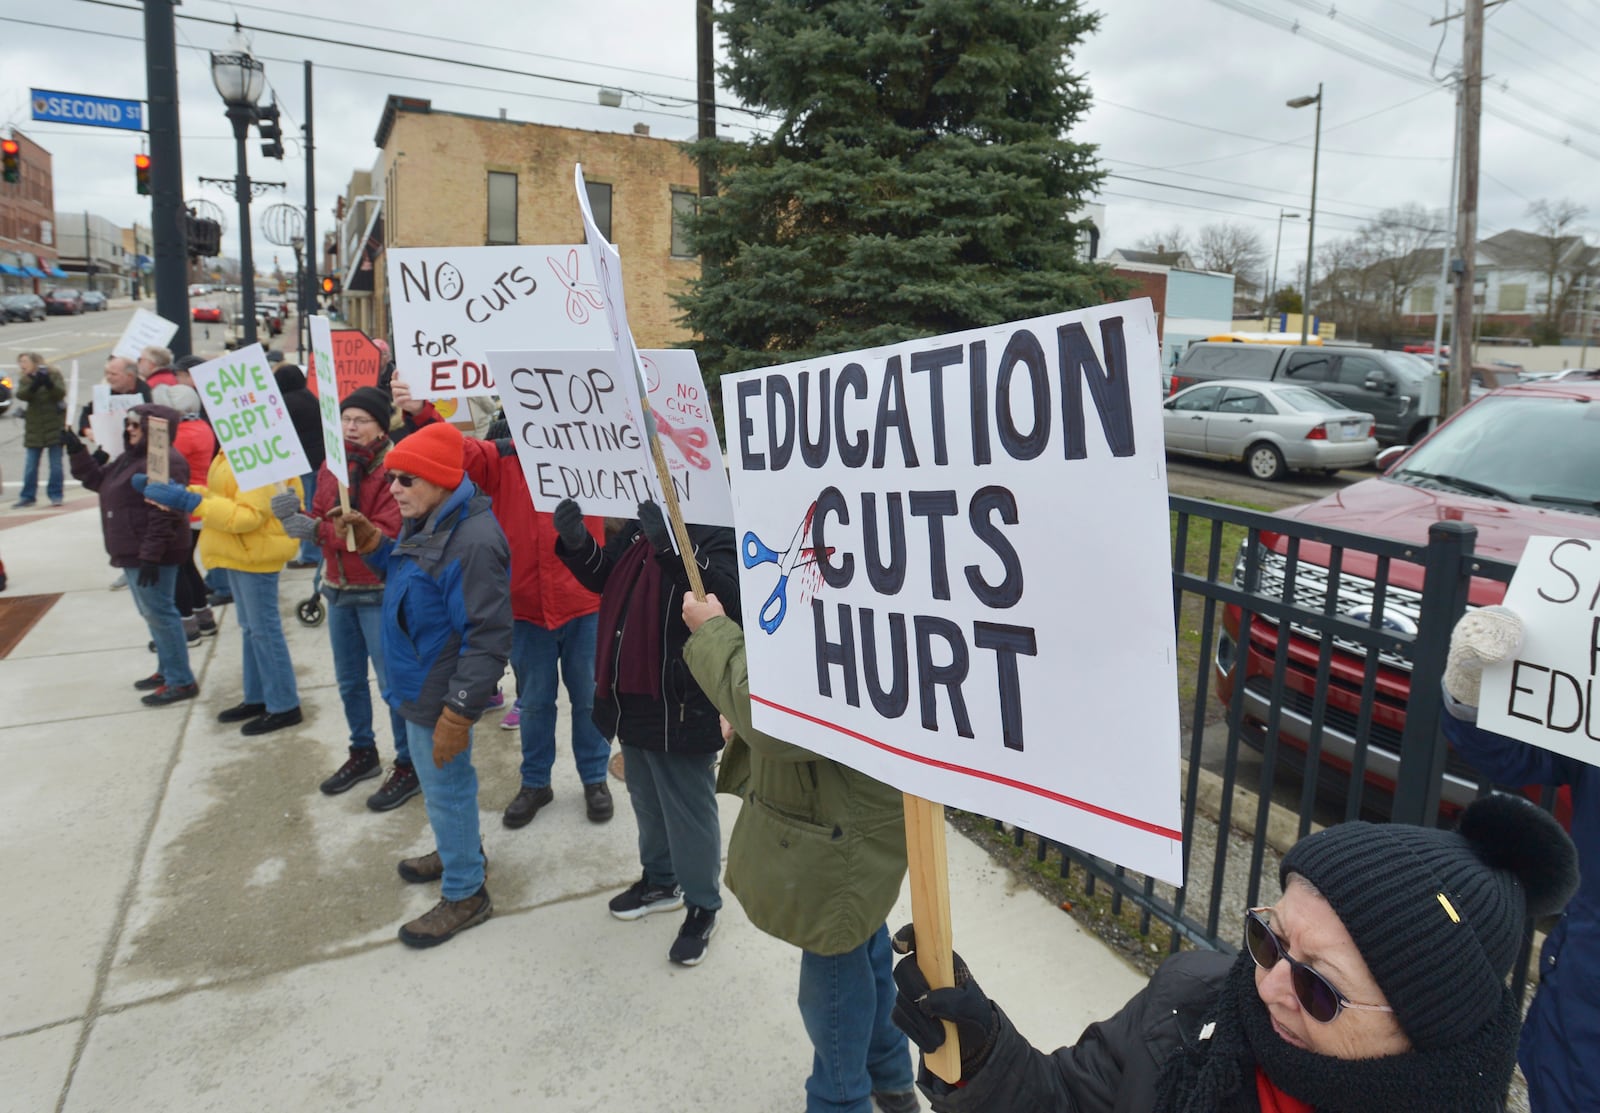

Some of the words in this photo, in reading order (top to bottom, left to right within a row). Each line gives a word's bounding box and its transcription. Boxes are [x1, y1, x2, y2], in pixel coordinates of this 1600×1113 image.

[48, 98, 121, 122] SECOND
[126, 106, 141, 119] ST
[400, 261, 464, 303] NO
[465, 265, 538, 324] CUTS
[309, 358, 376, 377] EATION
[335, 339, 363, 356] TOP
[205, 362, 267, 405] SAVE
[232, 391, 256, 408] THE
[510, 367, 615, 415] STOP
[677, 383, 698, 400] NO
[736, 316, 1136, 471] EDUCATION
[666, 397, 709, 423] CUTS!
[521, 421, 642, 450] CUTTING
[536, 461, 690, 503] EDUCATIN
[812, 485, 1024, 609] CUTS
[812, 598, 1038, 752] HURT
